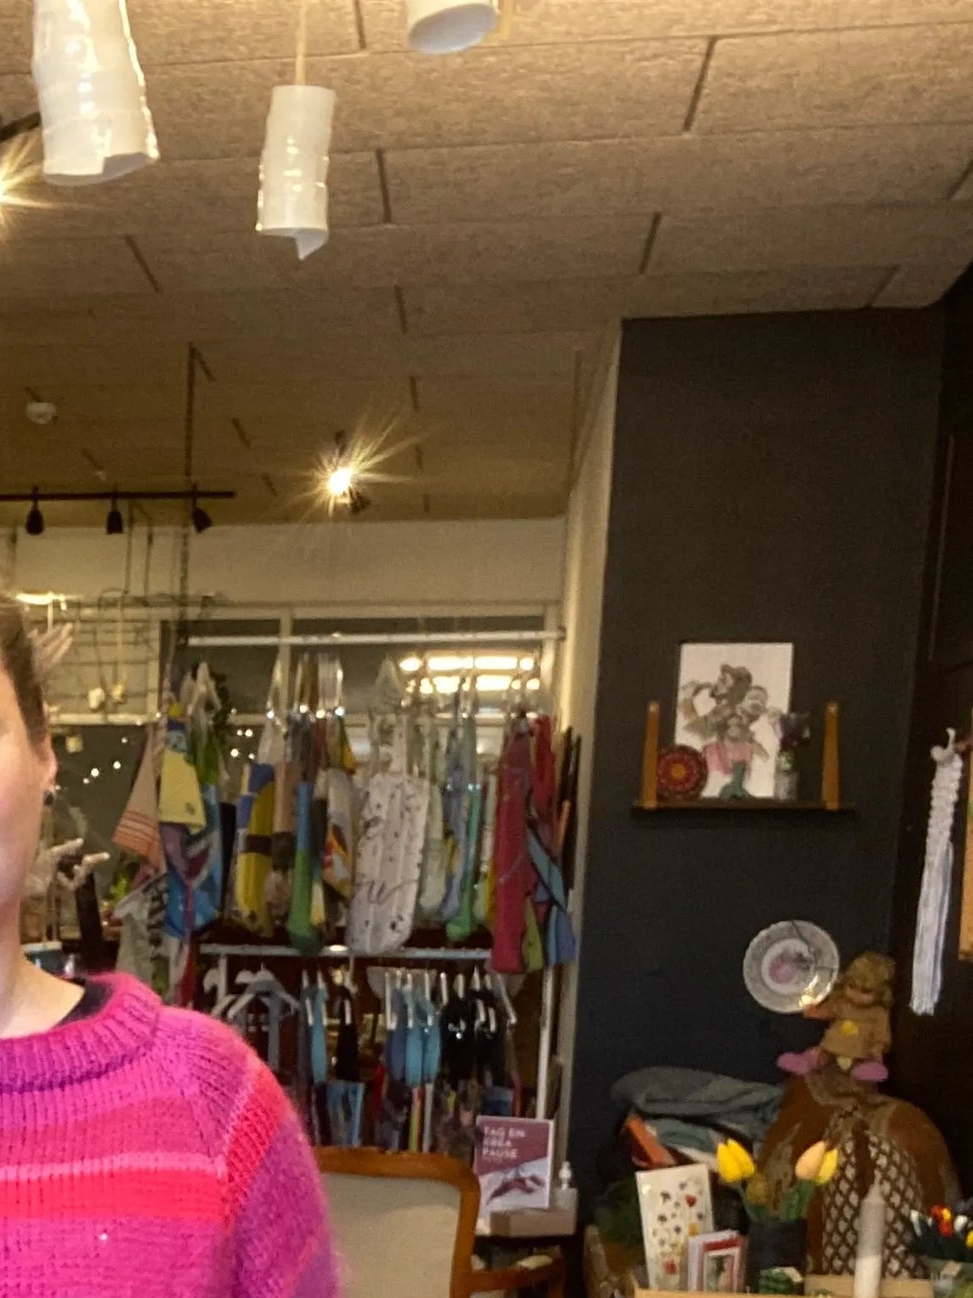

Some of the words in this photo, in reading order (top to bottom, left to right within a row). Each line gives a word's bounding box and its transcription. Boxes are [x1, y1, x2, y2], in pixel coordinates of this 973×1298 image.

[484, 1126, 505, 1137] TAG
[508, 1127, 526, 1138] EN
[482, 1147, 518, 1159] PAUSE
